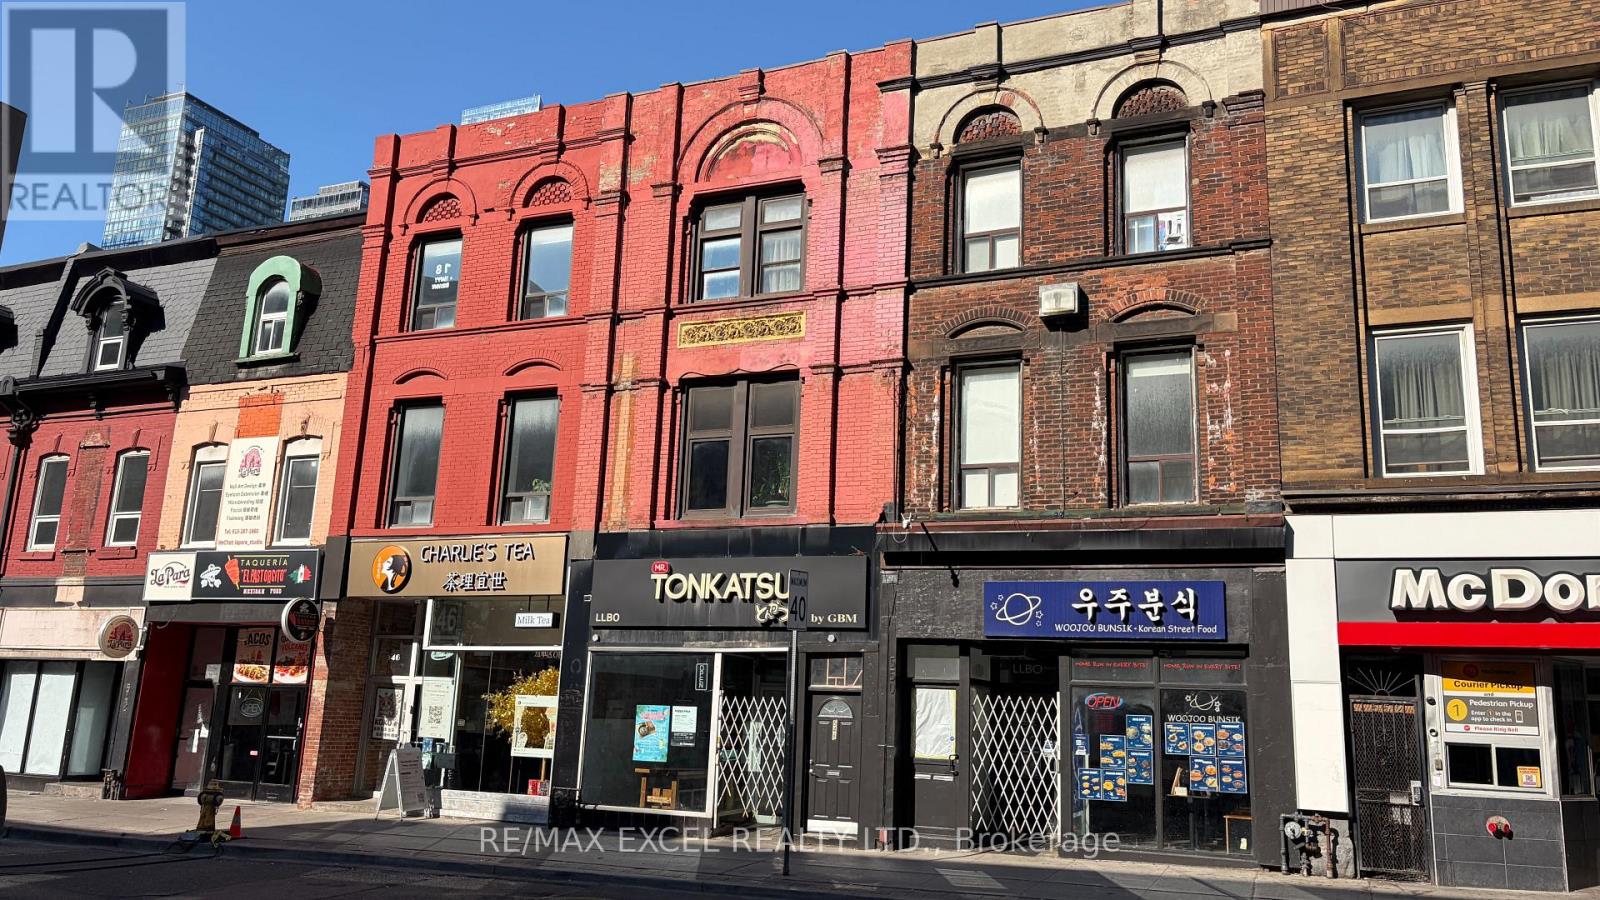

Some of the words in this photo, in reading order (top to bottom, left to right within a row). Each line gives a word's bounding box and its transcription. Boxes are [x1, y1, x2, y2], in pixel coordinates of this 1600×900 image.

[421, 543, 496, 563] CHARLIE'S
[505, 542, 534, 561] TEA
[240, 558, 288, 567] TAQUERÍA
[446, 571, 506, 591] 茶理宜世
[651, 573, 788, 600] TONKATSU
[790, 596, 805, 621] 40
[1071, 588, 1194, 621] 우주분식
[517, 615, 535, 624] Milk
[537, 616, 550, 624] Tea
[595, 613, 620, 622] LLBO
[811, 614, 824, 624] by
[827, 614, 857, 623] GBM
[1055, 624, 1095, 632] WOOJOO
[1098, 624, 1132, 632] BUNSIK
[1138, 625, 1166, 633] Korean
[1168, 625, 1195, 633] Street
[1197, 625, 1217, 633] Food
[1454, 680, 1488, 688] Courier
[1087, 695, 1120, 708] OPEN
[1509, 701, 1533, 709] Pickup
[1453, 704, 1460, 717] 1
[1168, 714, 1206, 722] WOOJOO
[1208, 715, 1240, 723] BUNSIK
